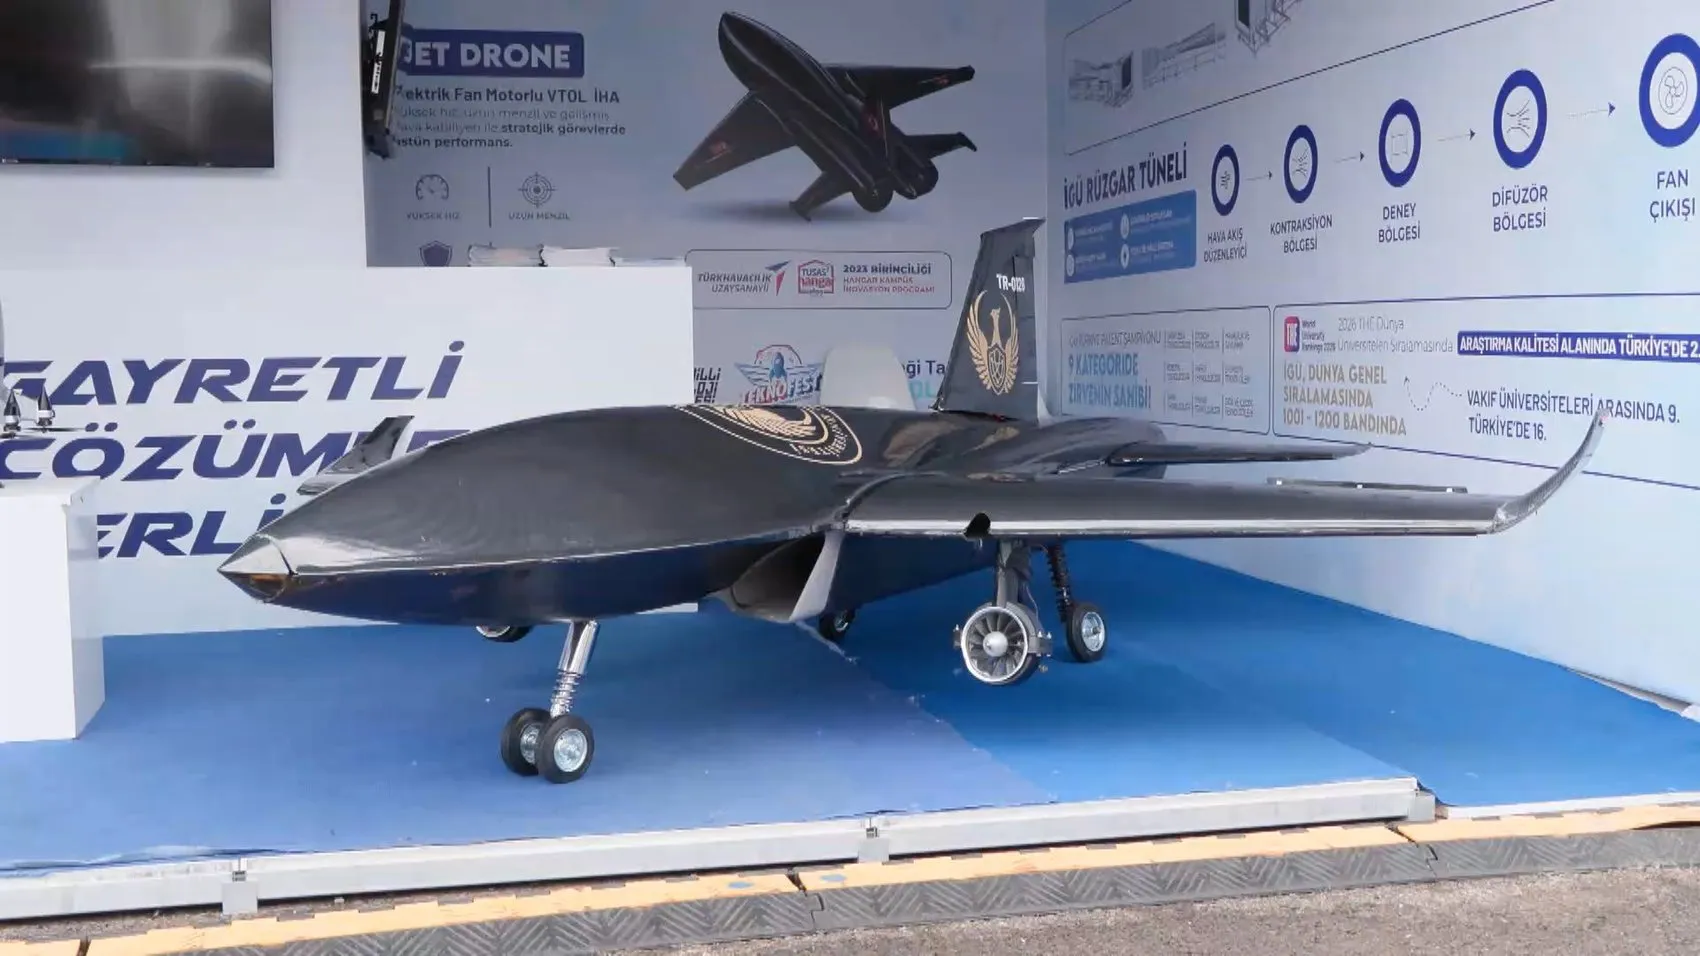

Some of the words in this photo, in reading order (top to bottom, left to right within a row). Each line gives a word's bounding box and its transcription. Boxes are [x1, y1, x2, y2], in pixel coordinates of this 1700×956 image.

[460, 43, 571, 69] DRONE
[454, 88, 482, 102] Fan
[486, 88, 543, 103] Motorlu
[547, 89, 587, 103] VTOL
[594, 87, 620, 103] İHA
[501, 123, 554, 136] stratejik
[558, 123, 626, 137] görevlerde
[435, 136, 513, 150] performans.
[1063, 177, 1083, 209] İGÜ
[1086, 162, 1136, 203] RÜZGAR
[1139, 142, 1188, 189] TÜNELİ
[1656, 169, 1689, 190] FAN
[1492, 183, 1548, 208] DİFÜZÖR
[1382, 203, 1417, 221] DENEY
[1493, 207, 1547, 232] BÖLGESİ
[1649, 197, 1695, 222] ÇIKIŞI
[1269, 213, 1334, 236] KONTRAKSİYON
[1378, 220, 1421, 244] BÖLGESİ
[1207, 231, 1226, 245] HAVA
[1283, 234, 1318, 254] BÖLGESİ
[1338, 317, 1356, 331] 2026
[1460, 335, 1513, 354] ARAŞTIRMA
[1514, 333, 1559, 353] KALİTESİ
[1560, 340, 1616, 355] ALANINDA
[1618, 334, 1689, 358] TÜRKİYE'DE
[3, 340, 466, 406] GAYRETLİ
[1348, 363, 1387, 384] GENEL
[1283, 385, 1374, 409] SIRALAMASINDA
[1467, 389, 1496, 408] VAKIF
[1498, 387, 1593, 416] ÜNİVERSİTELERİ
[1597, 399, 1665, 423] ARASINDA
[1668, 404, 1680, 424] 9.
[1283, 408, 1304, 426] 1001
[1314, 410, 1340, 430] 1200
[1343, 412, 1407, 436] BANDINDA
[1468, 414, 1531, 440] TÜRKİYE'DE
[1533, 423, 1547, 441] 16.
